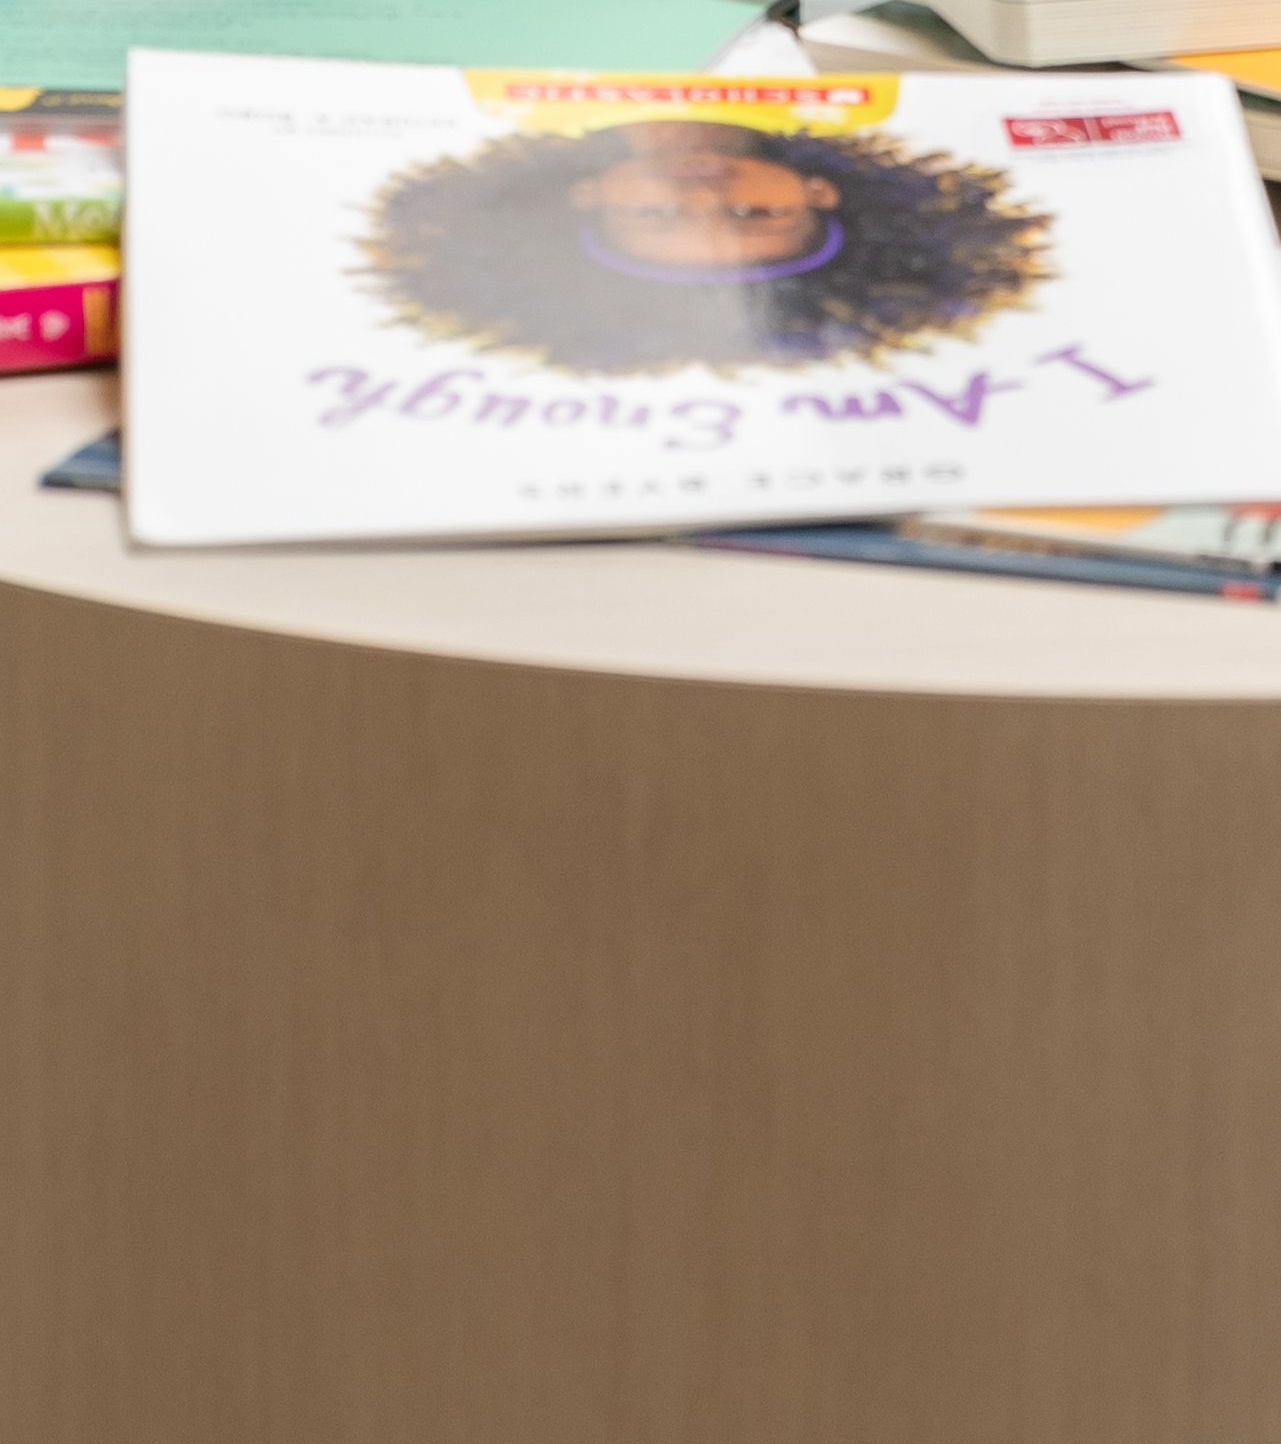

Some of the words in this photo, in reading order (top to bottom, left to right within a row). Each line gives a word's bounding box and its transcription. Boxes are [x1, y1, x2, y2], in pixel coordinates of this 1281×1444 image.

[780, 370, 1025, 429] Am
[1037, 344, 1157, 402] I
[306, 365, 744, 453] Enough
